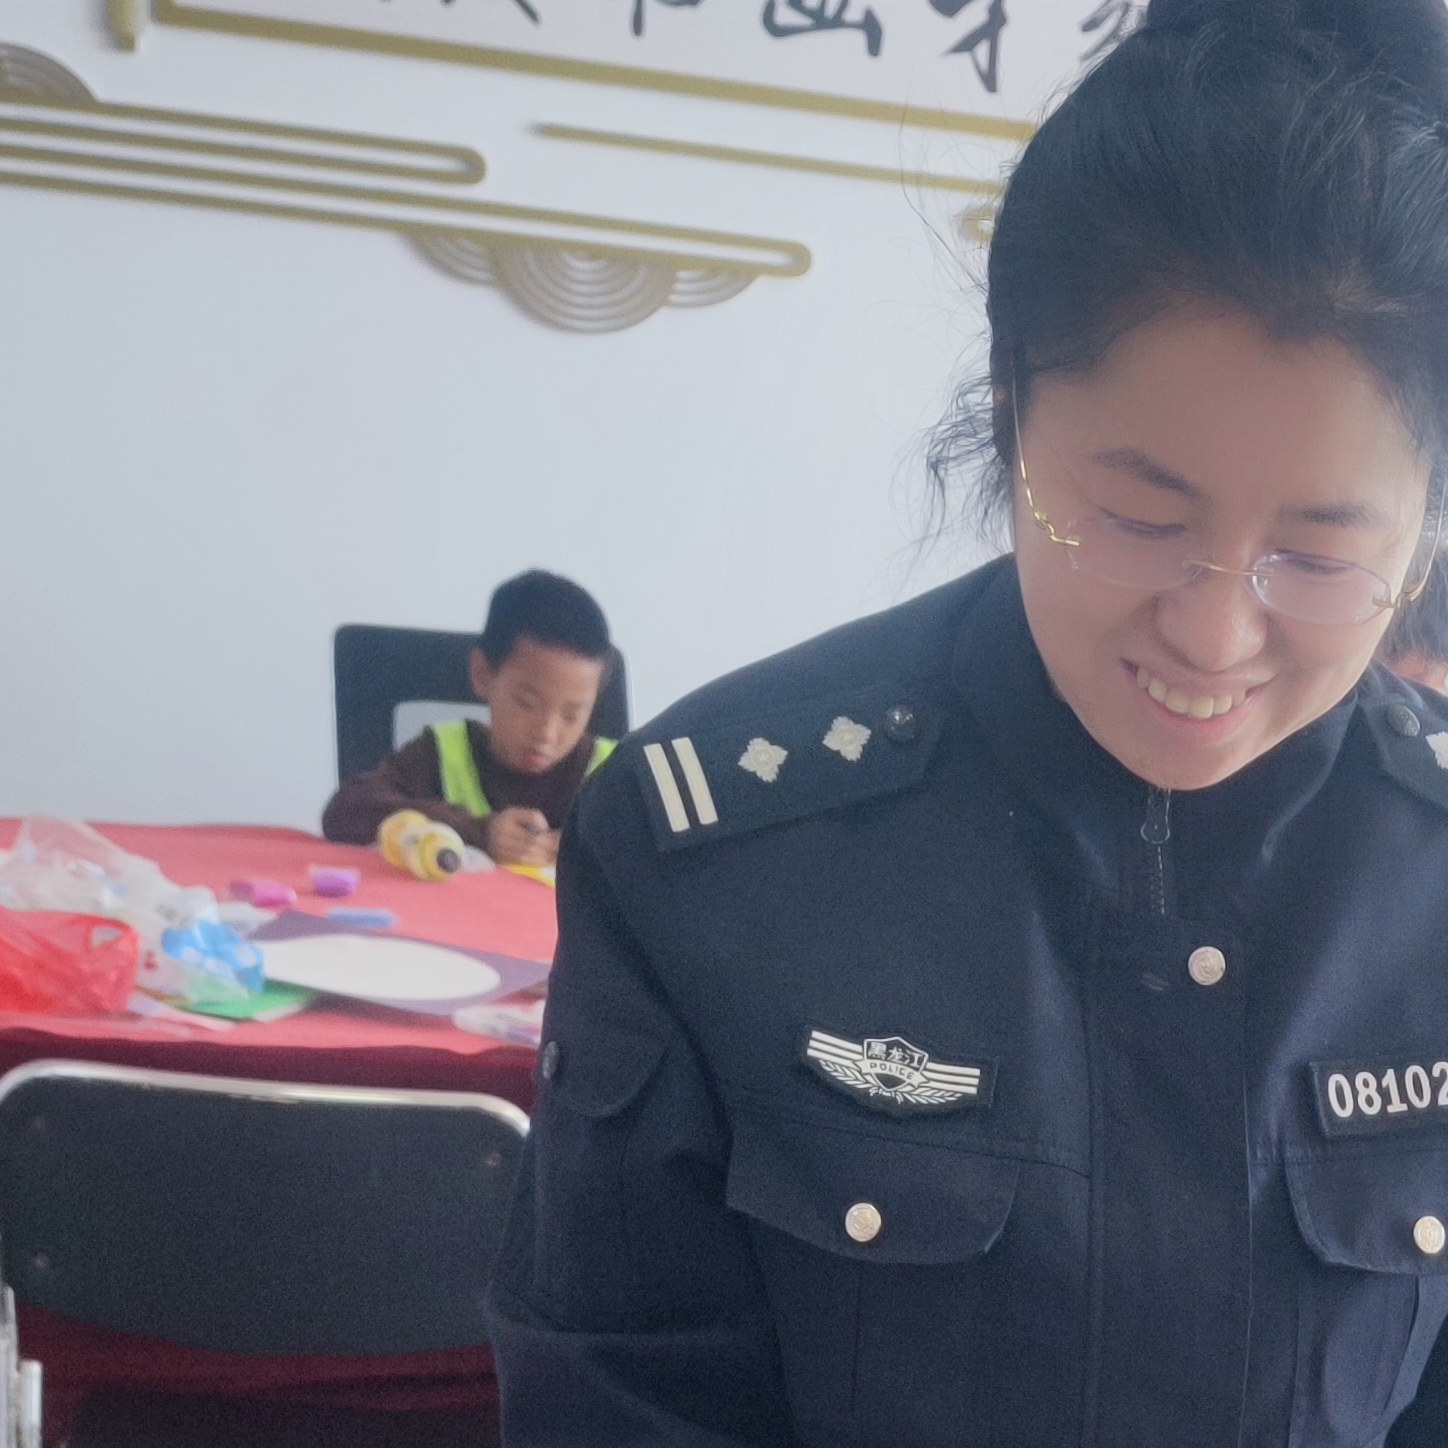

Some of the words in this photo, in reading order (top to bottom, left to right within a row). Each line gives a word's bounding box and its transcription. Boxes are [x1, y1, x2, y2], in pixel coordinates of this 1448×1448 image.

[867, 1041, 923, 1068] 黑龙江
[869, 1061, 915, 1080] POLICE
